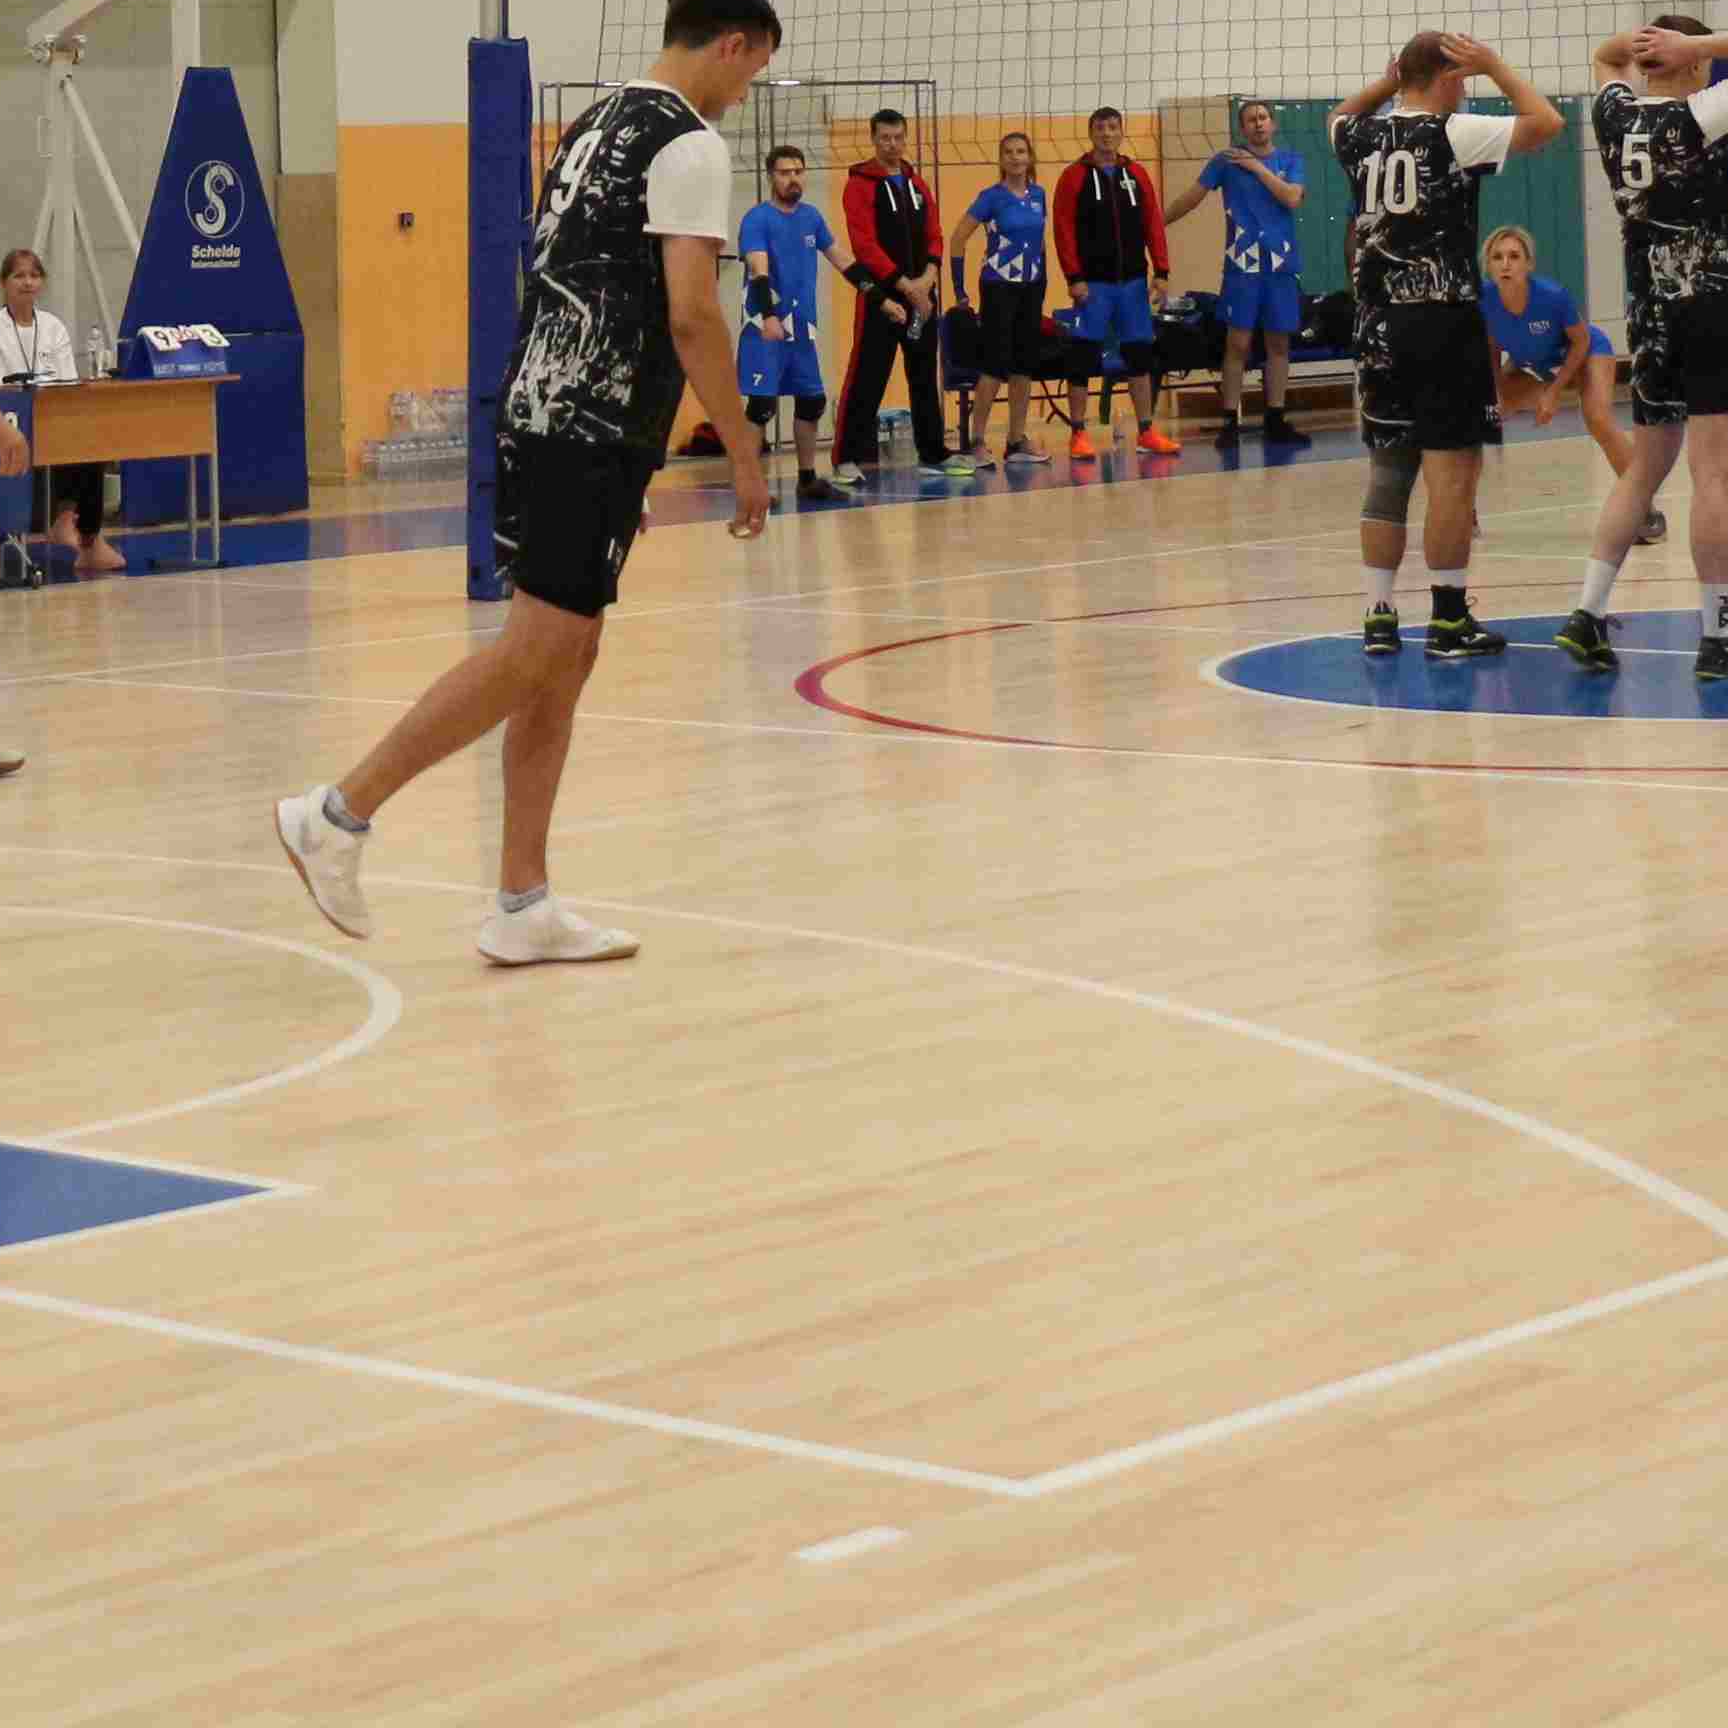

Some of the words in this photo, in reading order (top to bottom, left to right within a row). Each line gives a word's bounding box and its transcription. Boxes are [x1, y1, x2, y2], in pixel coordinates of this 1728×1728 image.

[550, 129, 602, 215] 9
[1361, 150, 1417, 214] 10
[1621, 133, 1653, 190] 5
